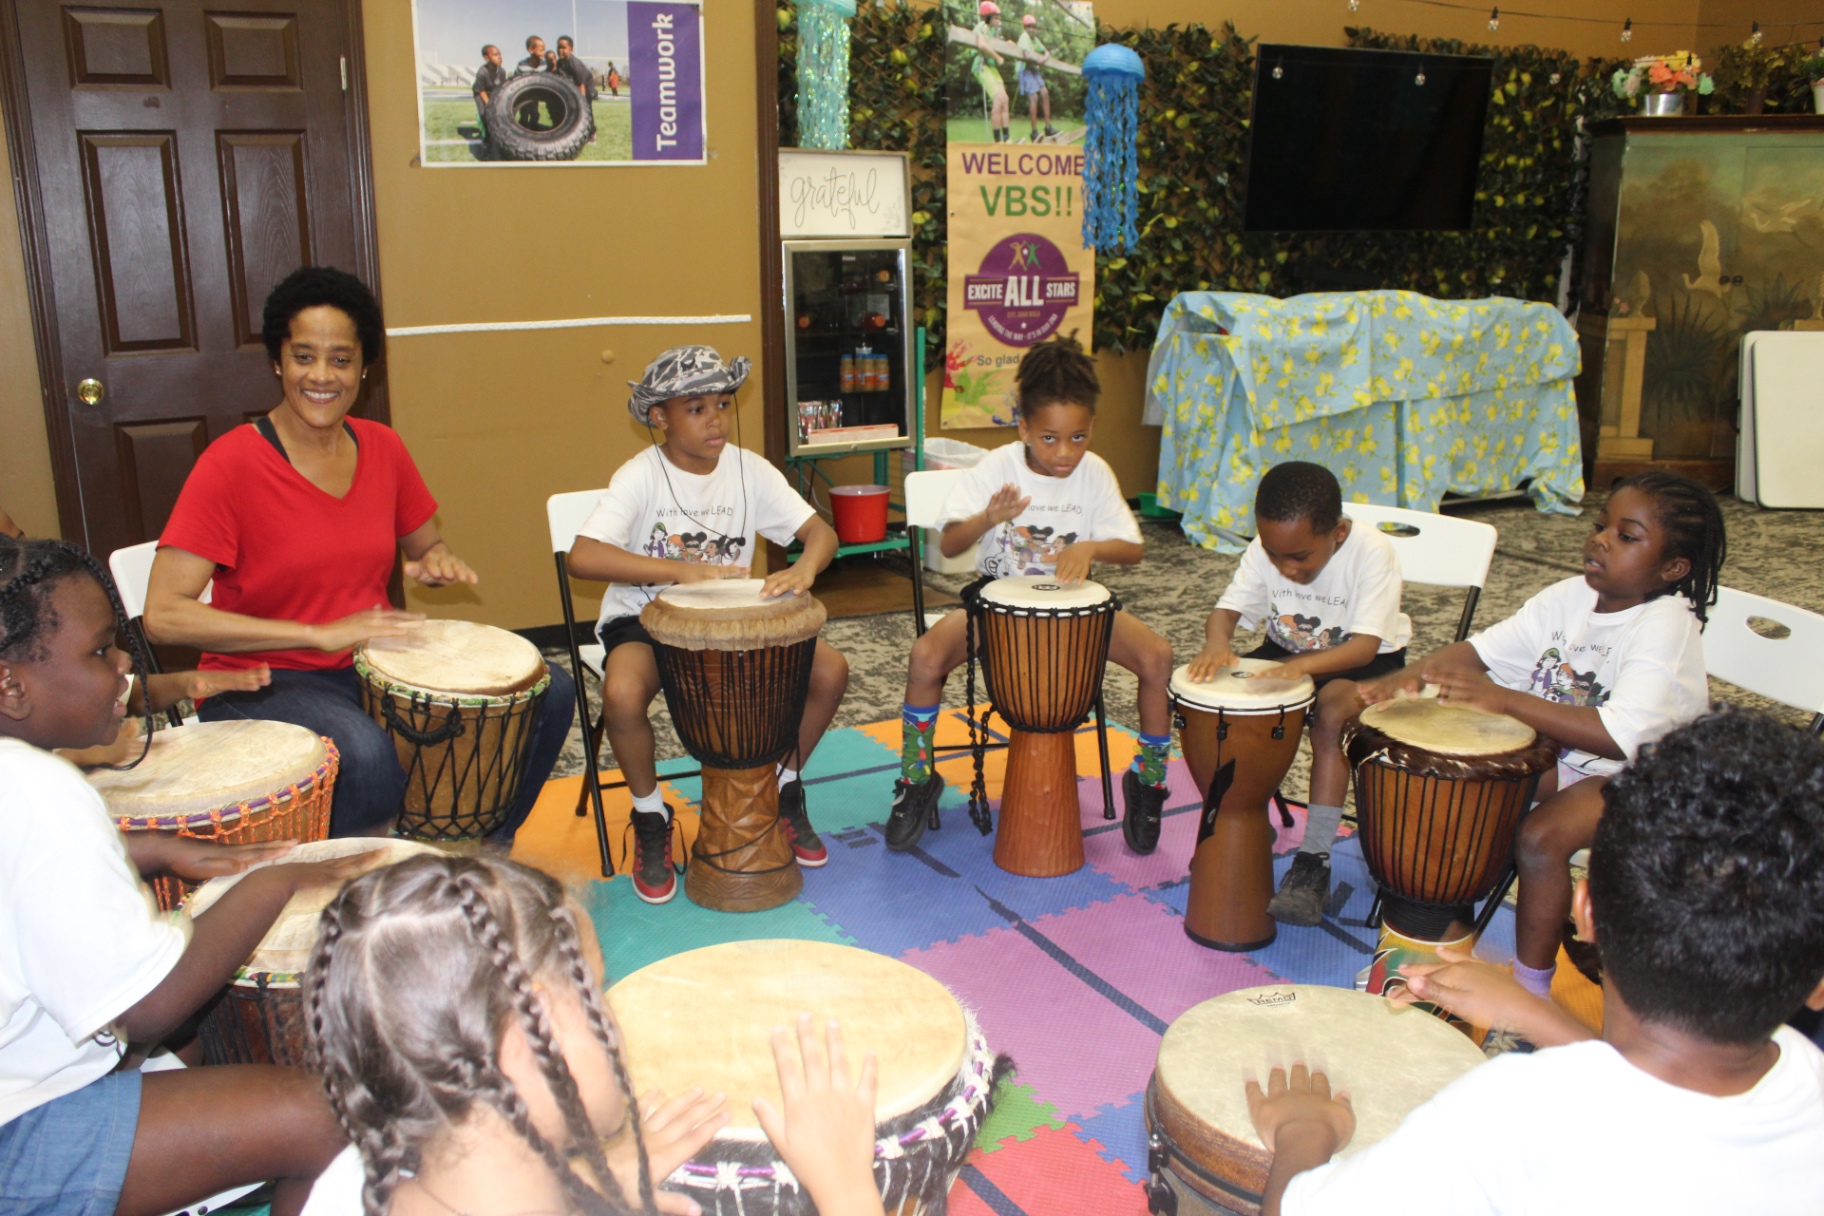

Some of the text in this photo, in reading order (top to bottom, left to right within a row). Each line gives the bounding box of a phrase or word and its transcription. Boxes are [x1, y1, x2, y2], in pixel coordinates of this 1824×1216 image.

[652, 13, 677, 152] Teamwork
[962, 152, 1085, 176] WELCOME
[790, 166, 880, 230] grateful
[979, 185, 1073, 217] VBS!!
[967, 275, 1076, 307] EXCITE ALL STARS
[977, 354, 1020, 368] So glad
[656, 507, 678, 518] With
[680, 506, 699, 517] love
[711, 505, 734, 517] LEAD
